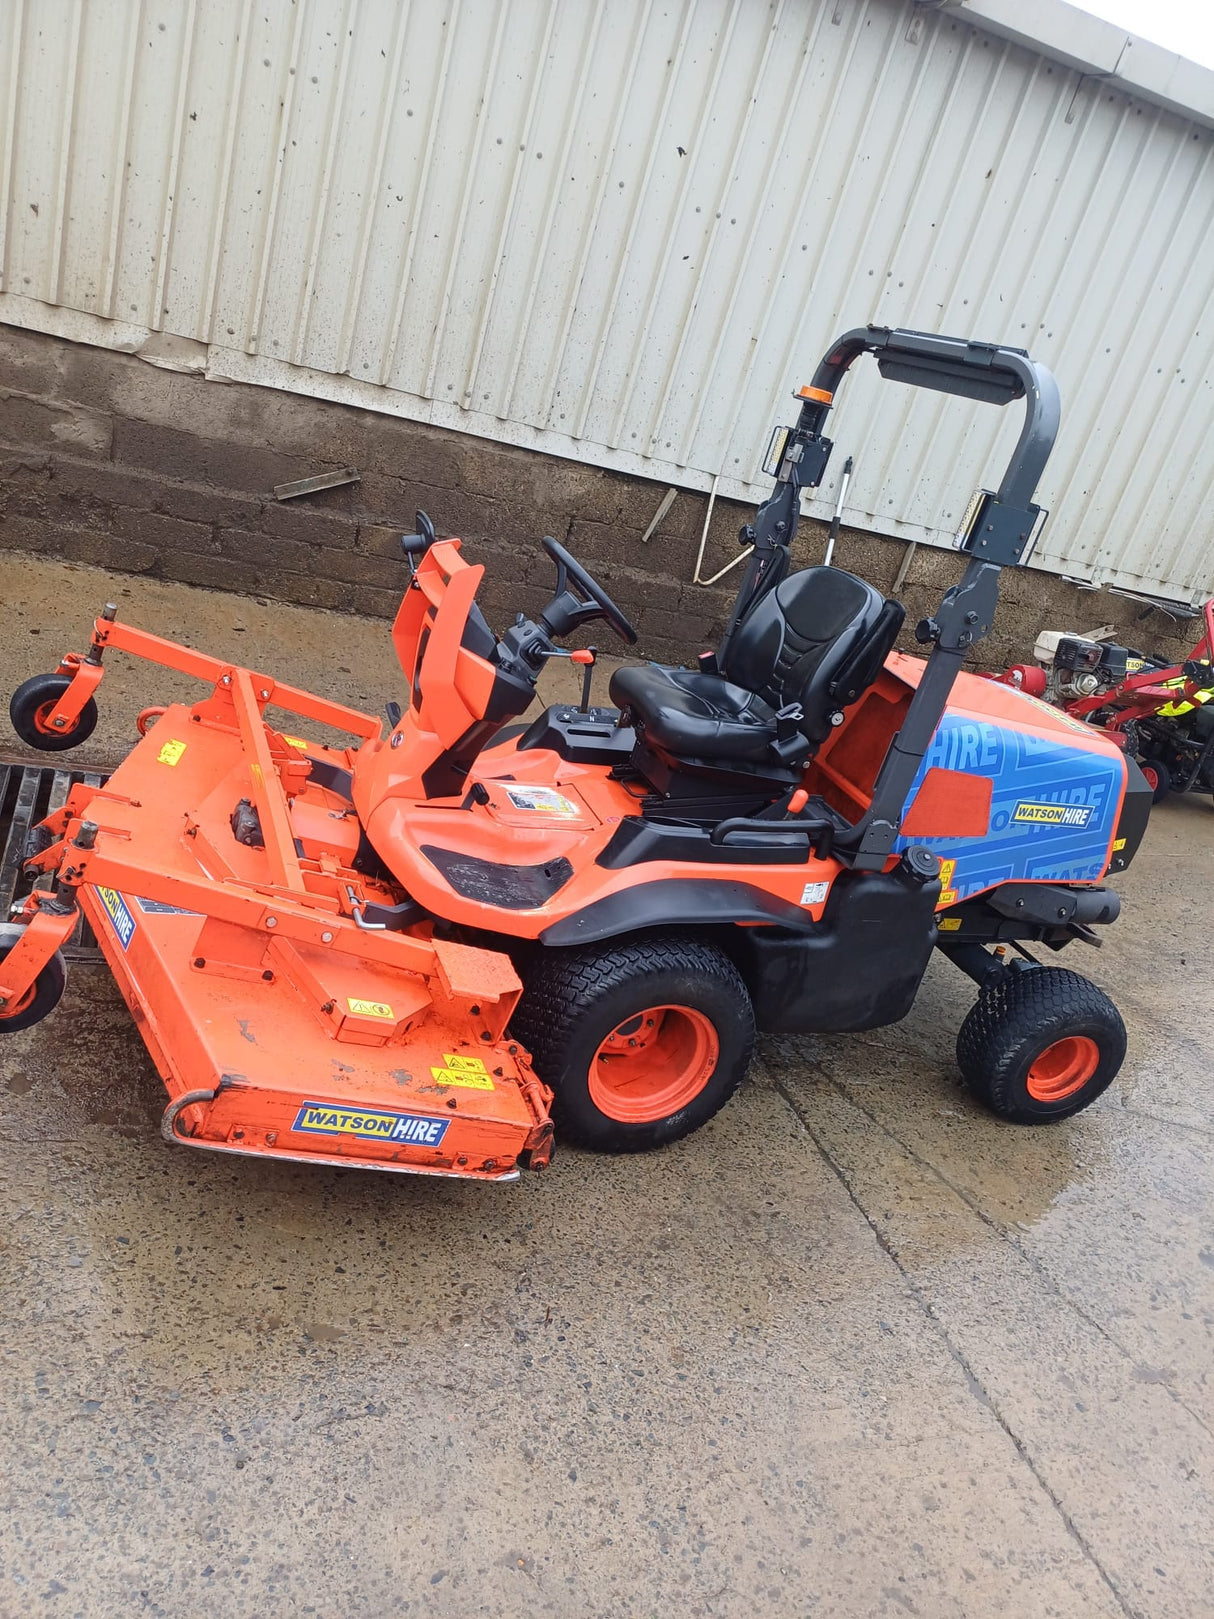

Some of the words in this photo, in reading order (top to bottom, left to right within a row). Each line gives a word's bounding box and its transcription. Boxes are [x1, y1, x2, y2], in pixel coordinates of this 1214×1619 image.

[924, 723, 998, 772] HIRE
[1018, 806, 1064, 820] WATSON
[1061, 808, 1090, 825] HIRE
[114, 903, 133, 944] HIRE
[307, 1110, 394, 1133] WATSON
[392, 1118, 442, 1142] HIRE
